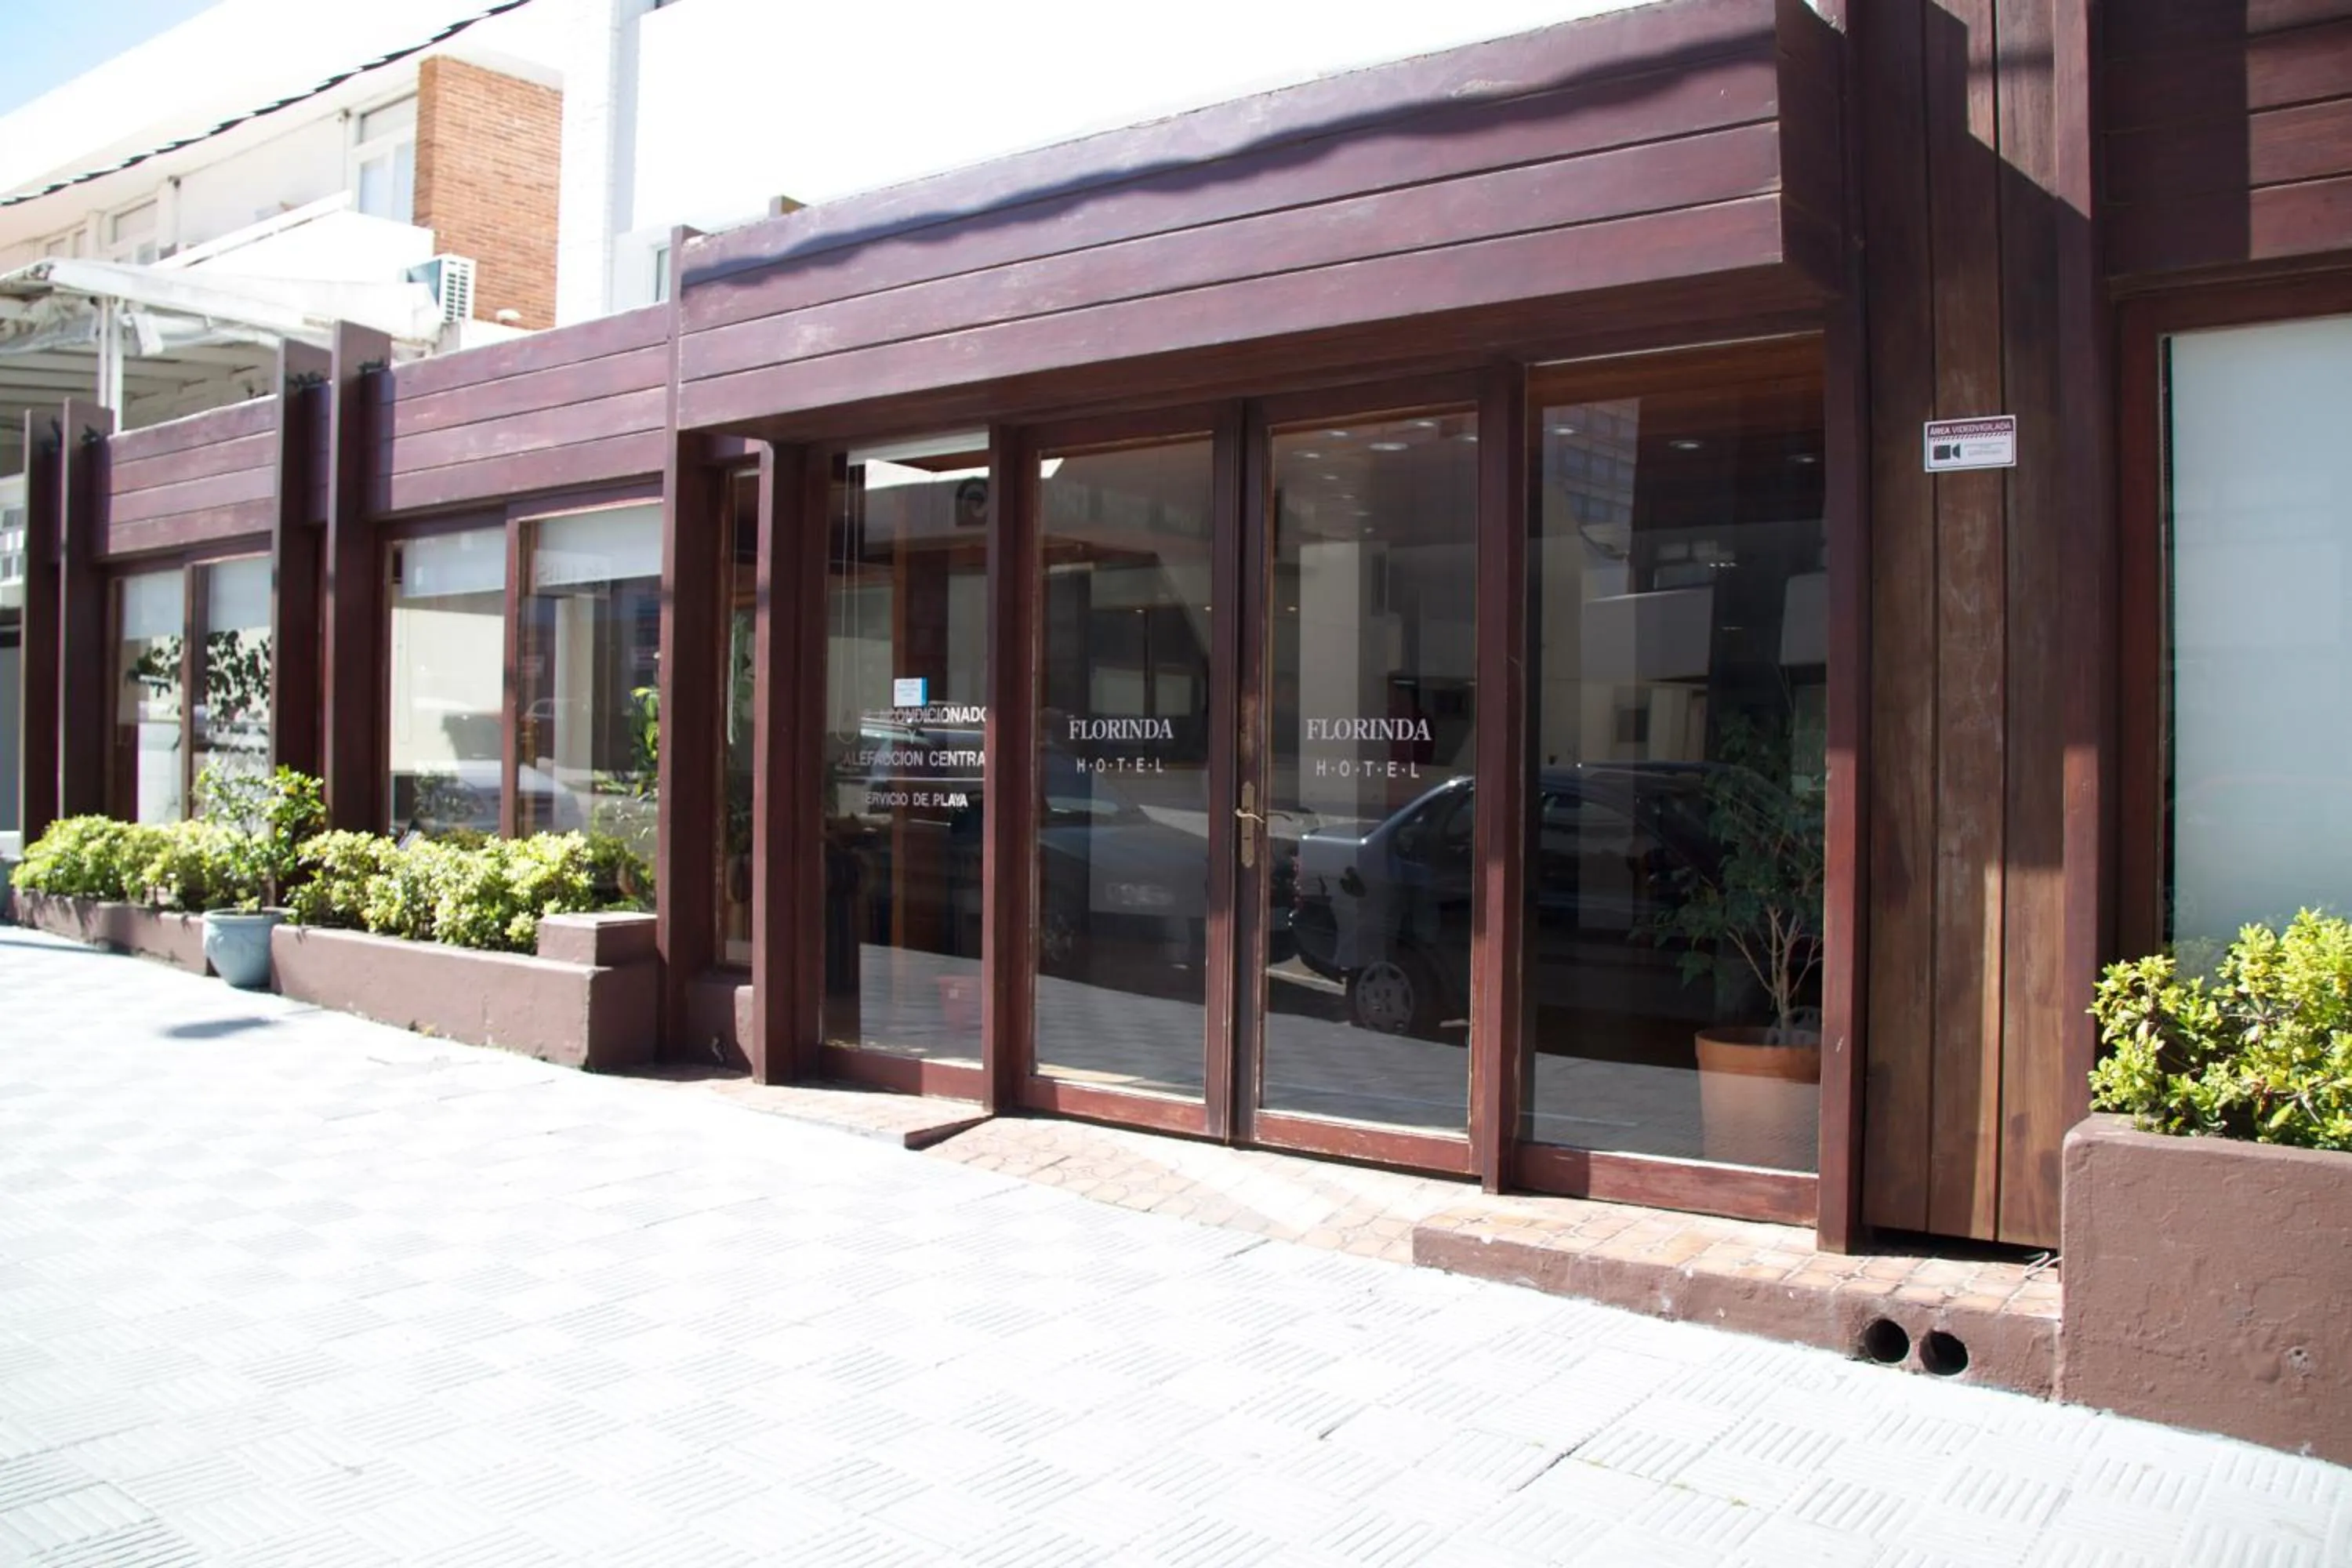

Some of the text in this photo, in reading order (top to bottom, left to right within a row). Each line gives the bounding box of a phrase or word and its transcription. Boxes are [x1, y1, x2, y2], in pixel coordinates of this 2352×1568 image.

[1069, 718, 1174, 739] FLORINDA
[1306, 718, 1432, 741] FLORINDA
[841, 750, 985, 767] ALEFACCION CENTRA
[863, 792, 968, 807] ERVICIO DE PLAYA
